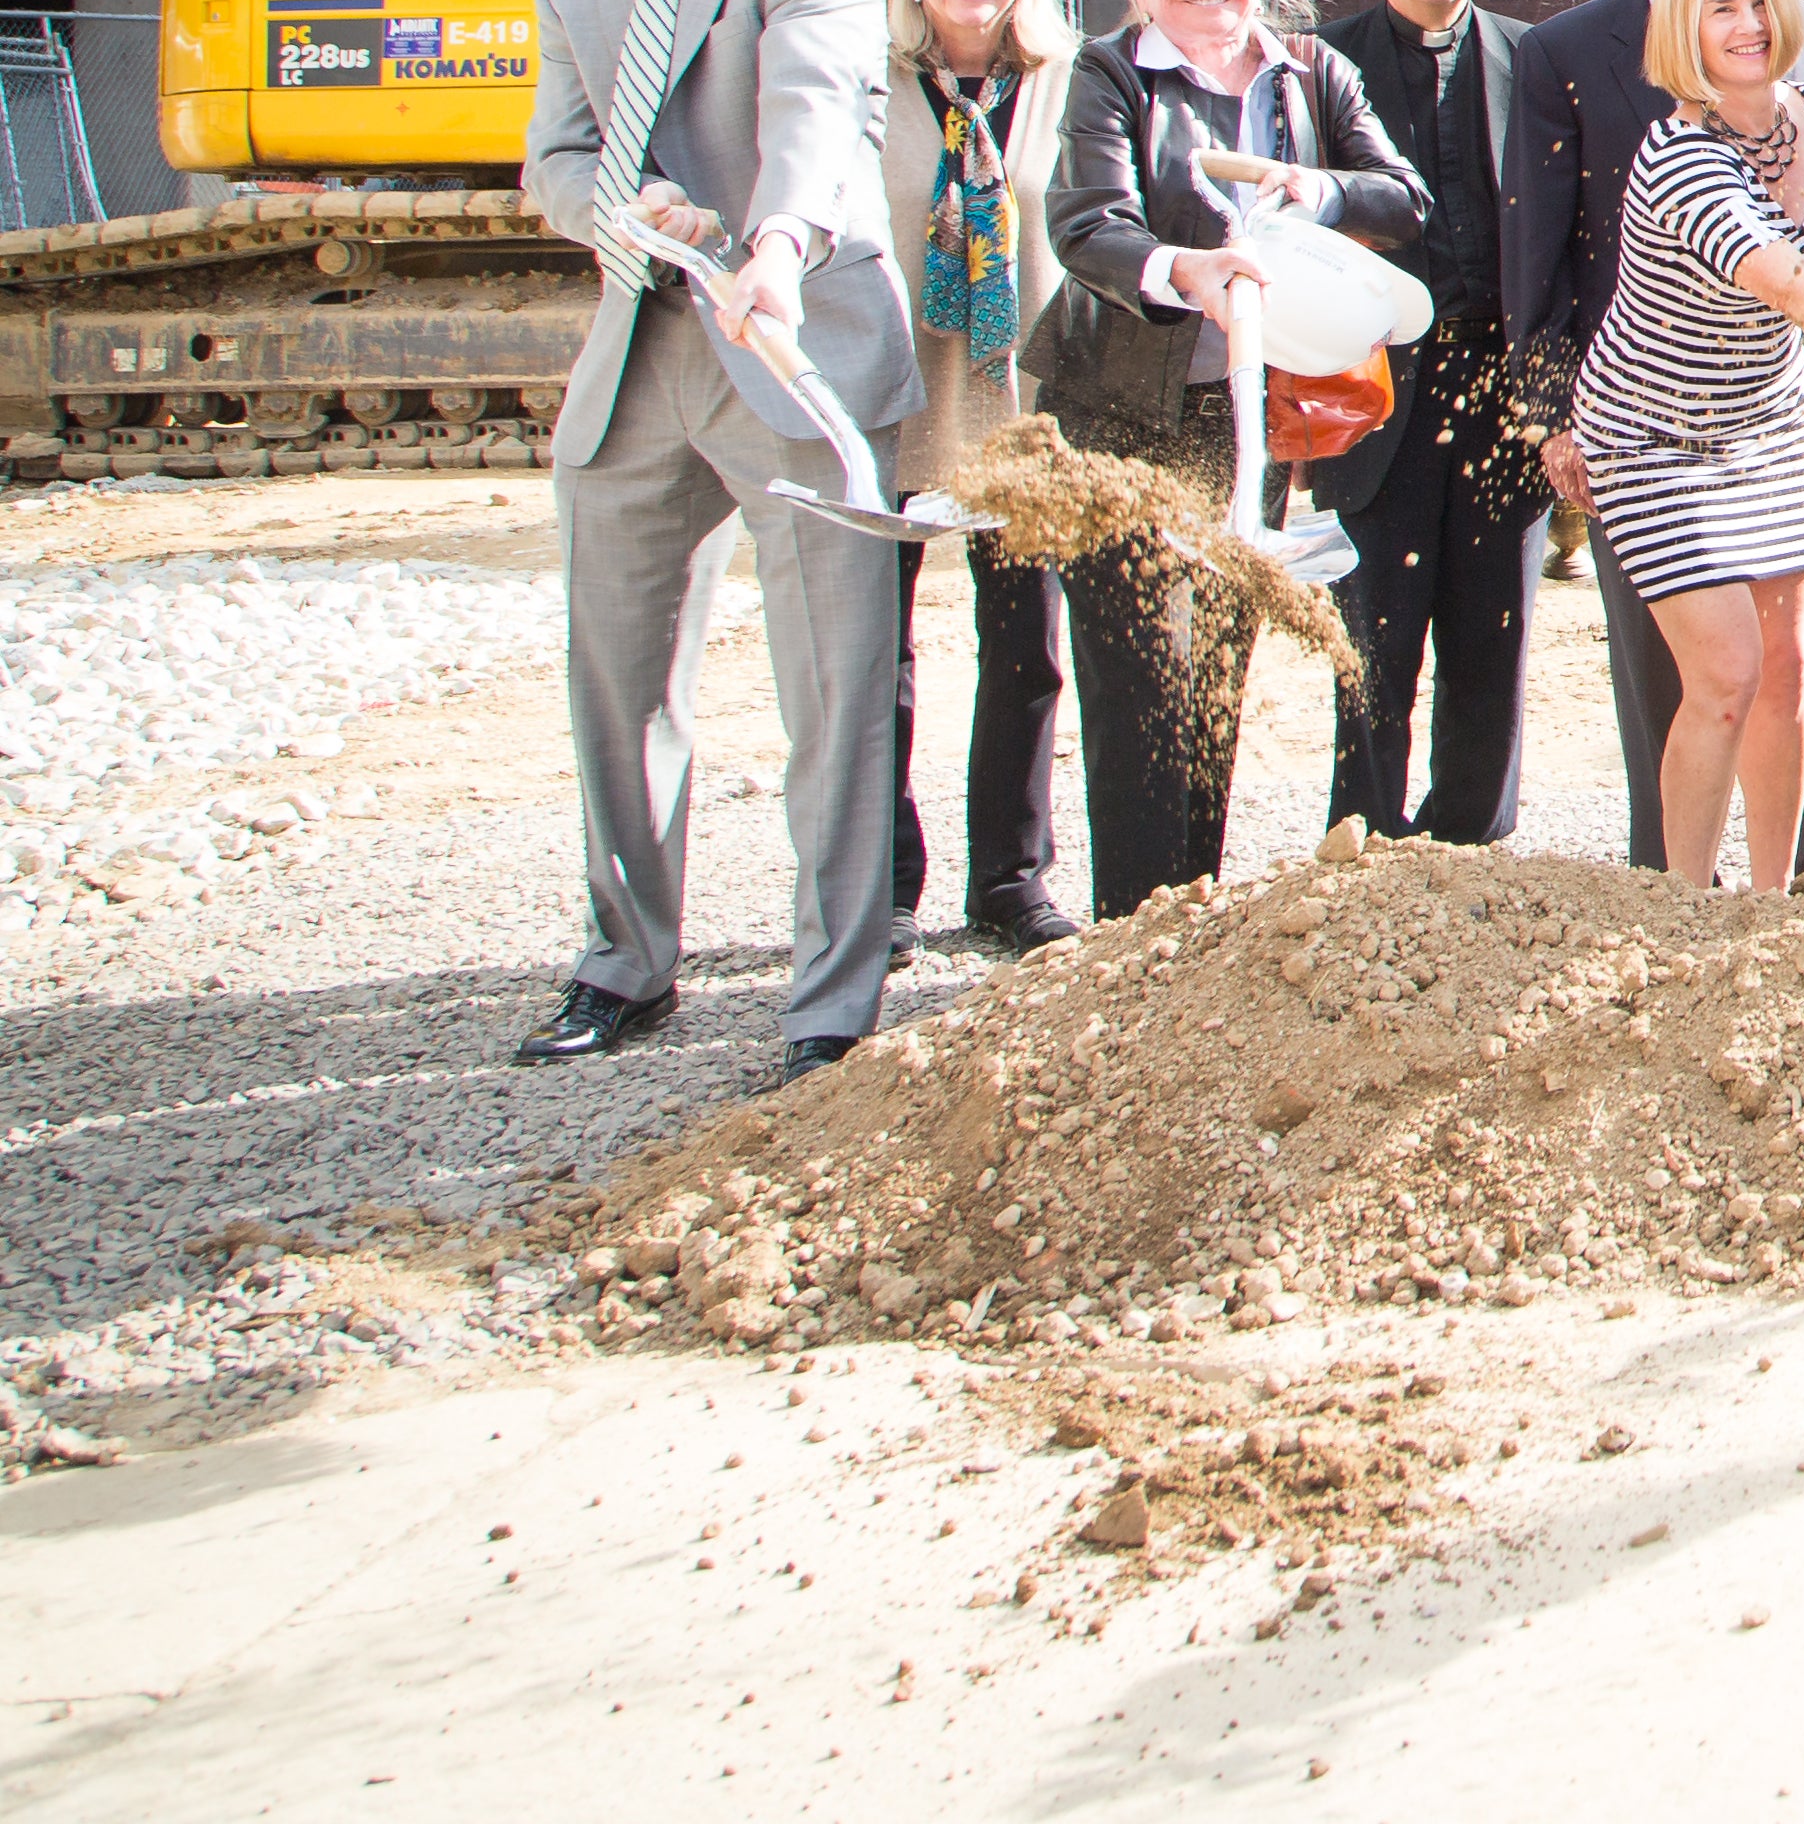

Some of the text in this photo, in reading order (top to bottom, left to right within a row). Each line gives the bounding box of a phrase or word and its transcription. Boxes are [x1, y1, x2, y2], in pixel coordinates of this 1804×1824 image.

[279, 24, 312, 44] PC
[448, 20, 530, 45] E-419
[395, 52, 527, 79] KOMATSU
[281, 69, 303, 85] LC
